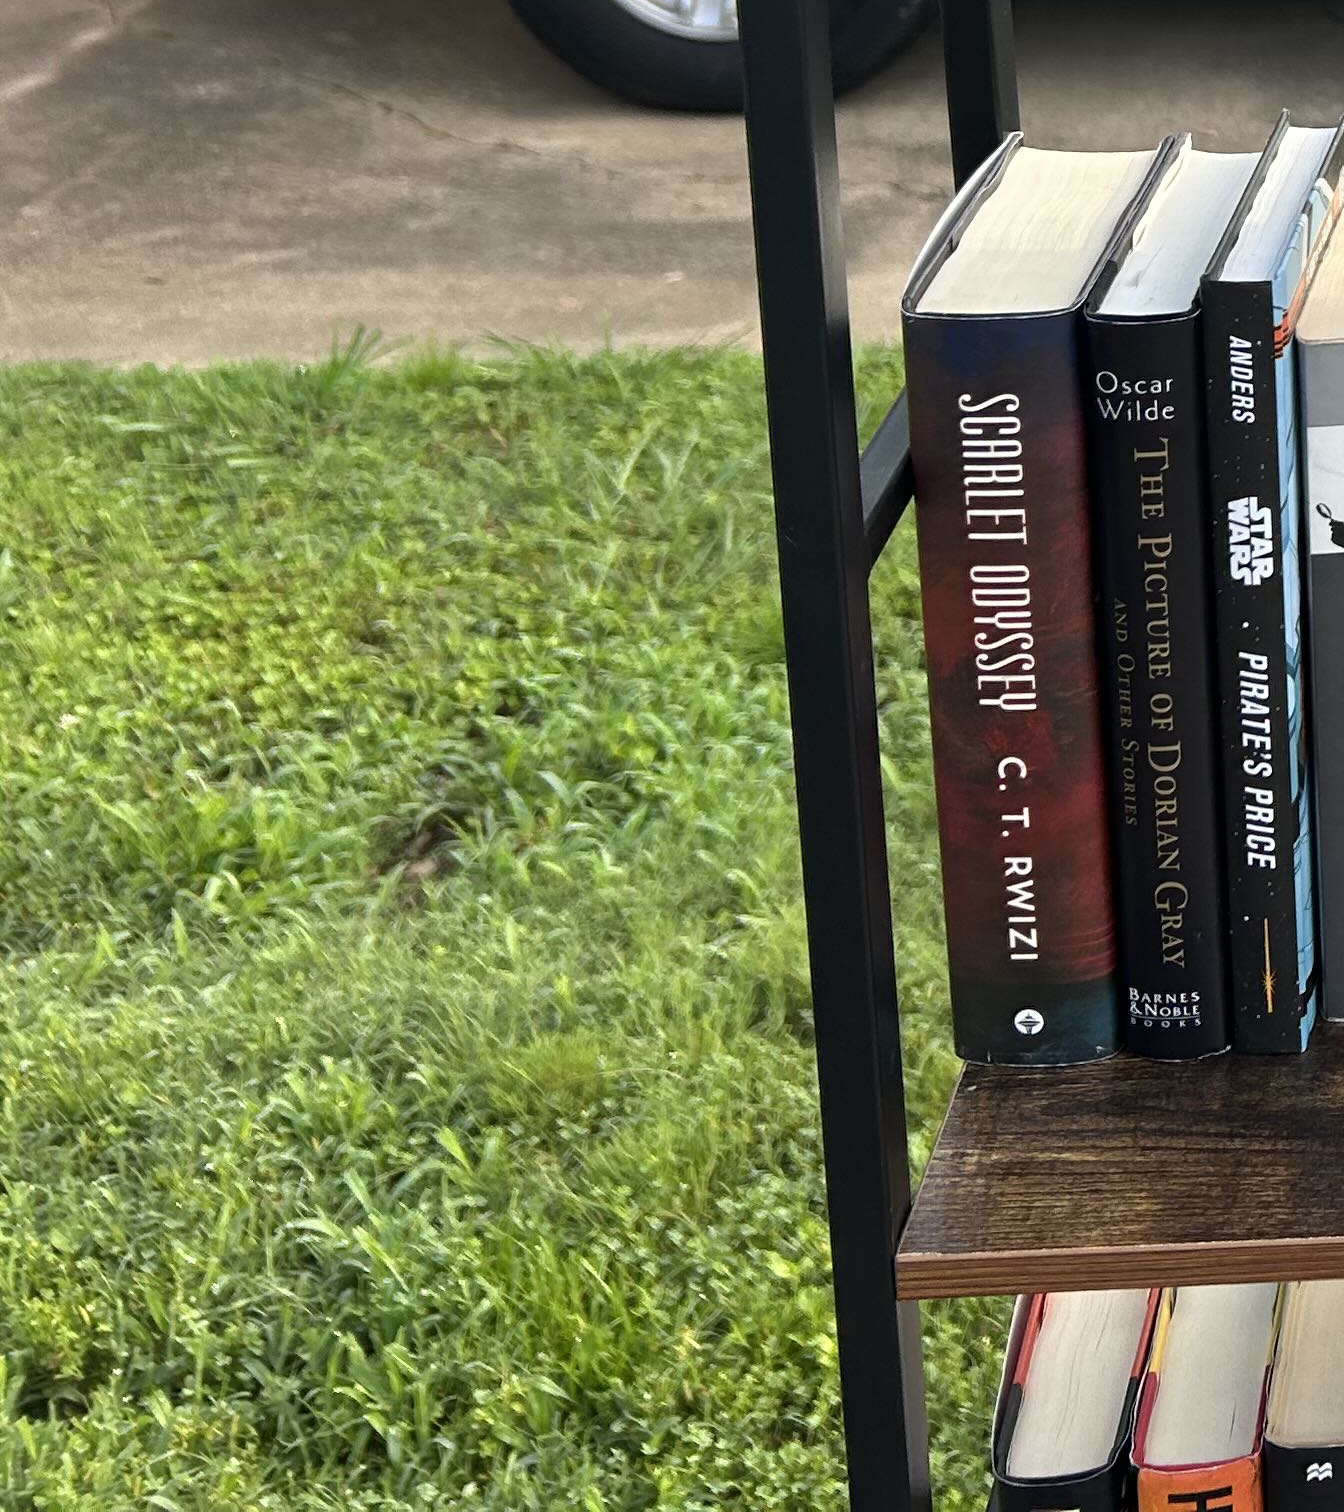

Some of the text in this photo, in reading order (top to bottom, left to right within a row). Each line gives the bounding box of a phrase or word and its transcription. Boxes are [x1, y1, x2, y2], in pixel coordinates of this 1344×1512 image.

[1095, 370, 1174, 395] Oscar
[1096, 397, 1175, 422] Wilde
[957, 393, 1038, 711] SCARLET ODYSSEY
[1133, 437, 1189, 968] THE PICTURE OF DORIAN GRAY
[1238, 651, 1278, 871] PIRATE'S PRICE
[997, 756, 1039, 961] C. T. RWIZI
